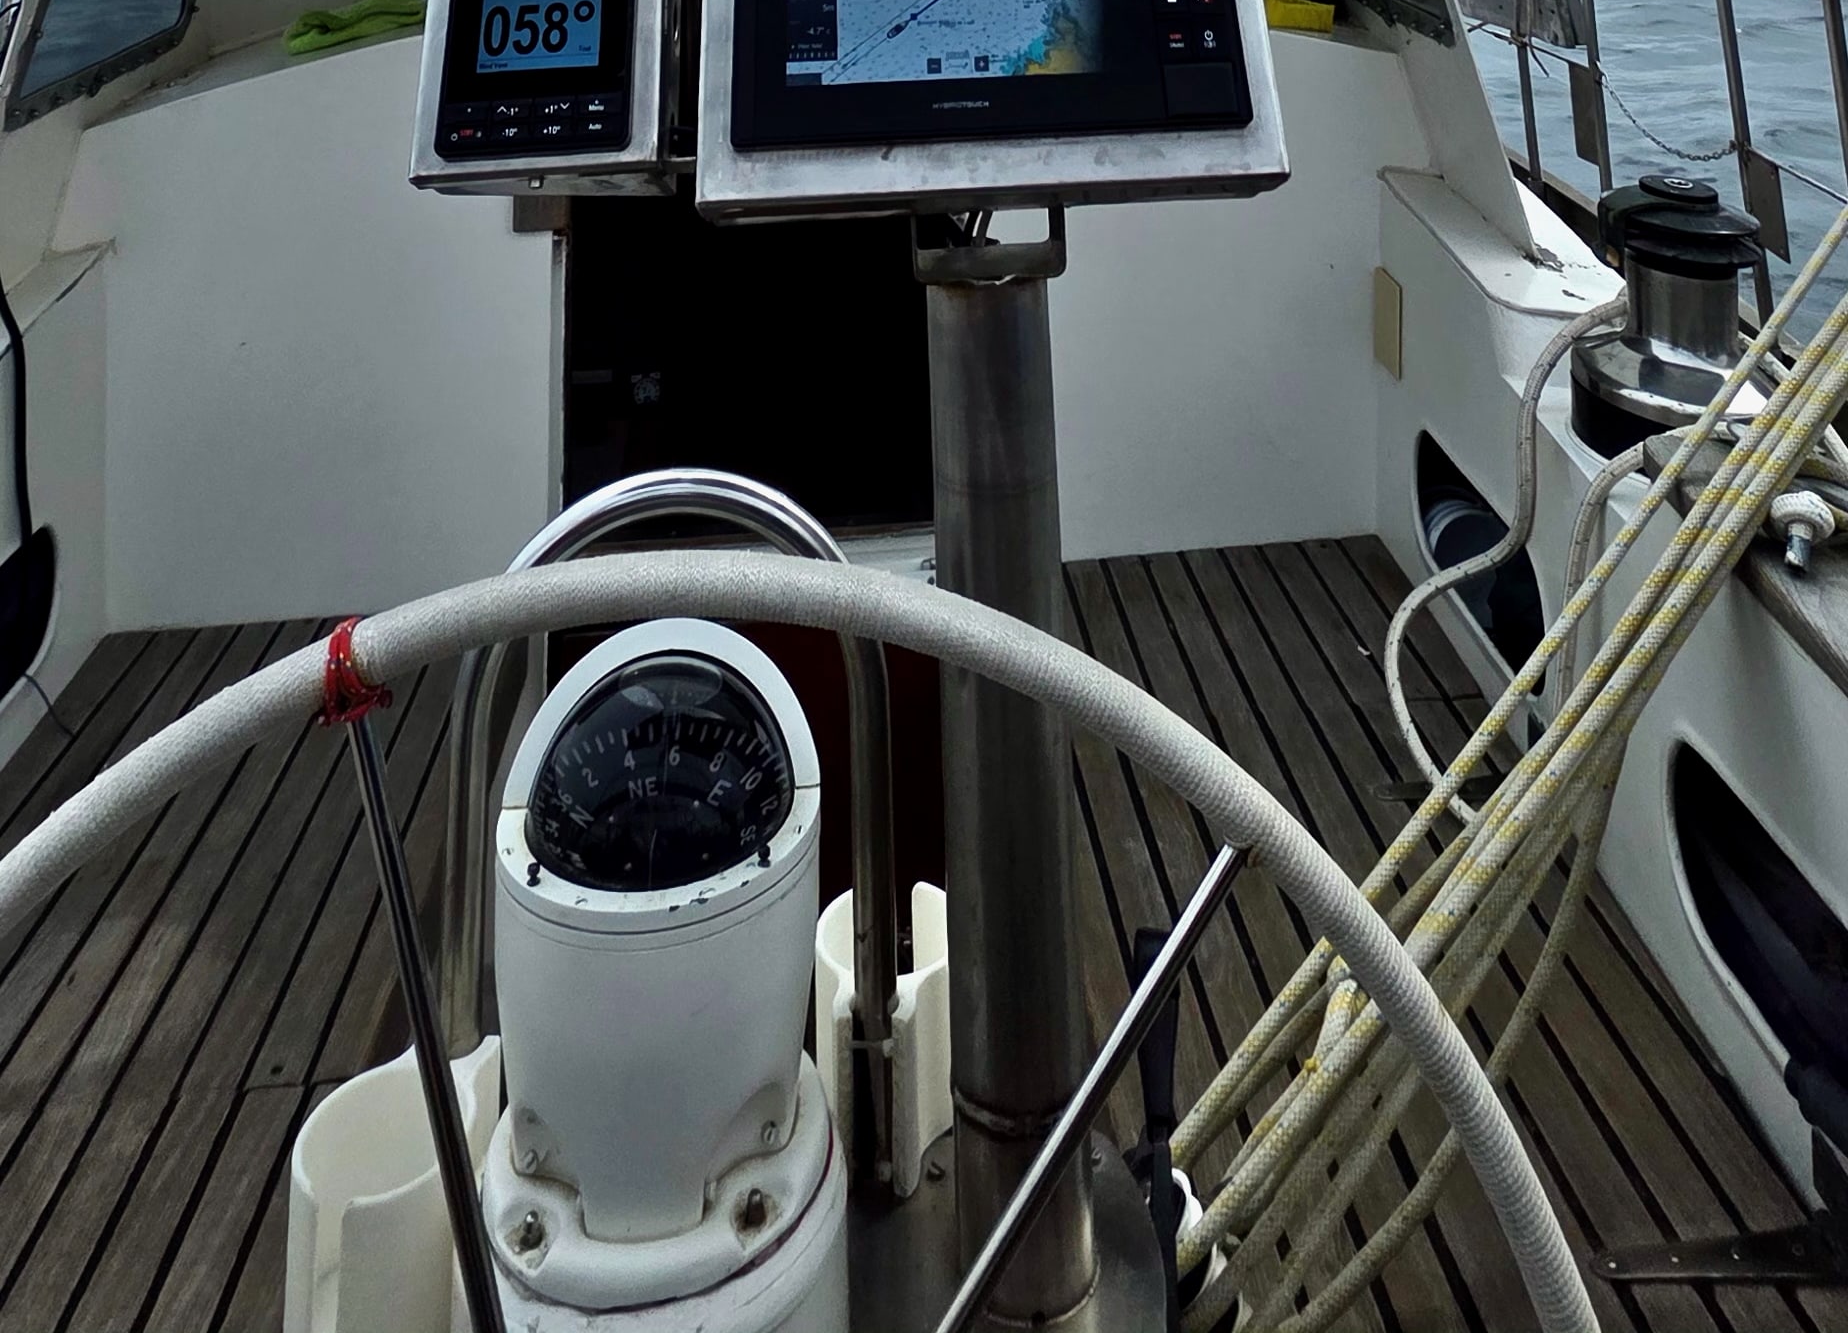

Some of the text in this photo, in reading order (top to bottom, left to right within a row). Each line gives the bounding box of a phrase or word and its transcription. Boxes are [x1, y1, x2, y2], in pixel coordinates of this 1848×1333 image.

[483, 0, 595, 58] 058°
[623, 750, 636, 771] 4
[668, 745, 680, 767] 6
[709, 752, 724, 772] 8
[582, 767, 599, 788] 2
[628, 777, 658, 798] NE
[740, 767, 762, 791] 10
[707, 779, 732, 806] E
[569, 804, 594, 829] N
